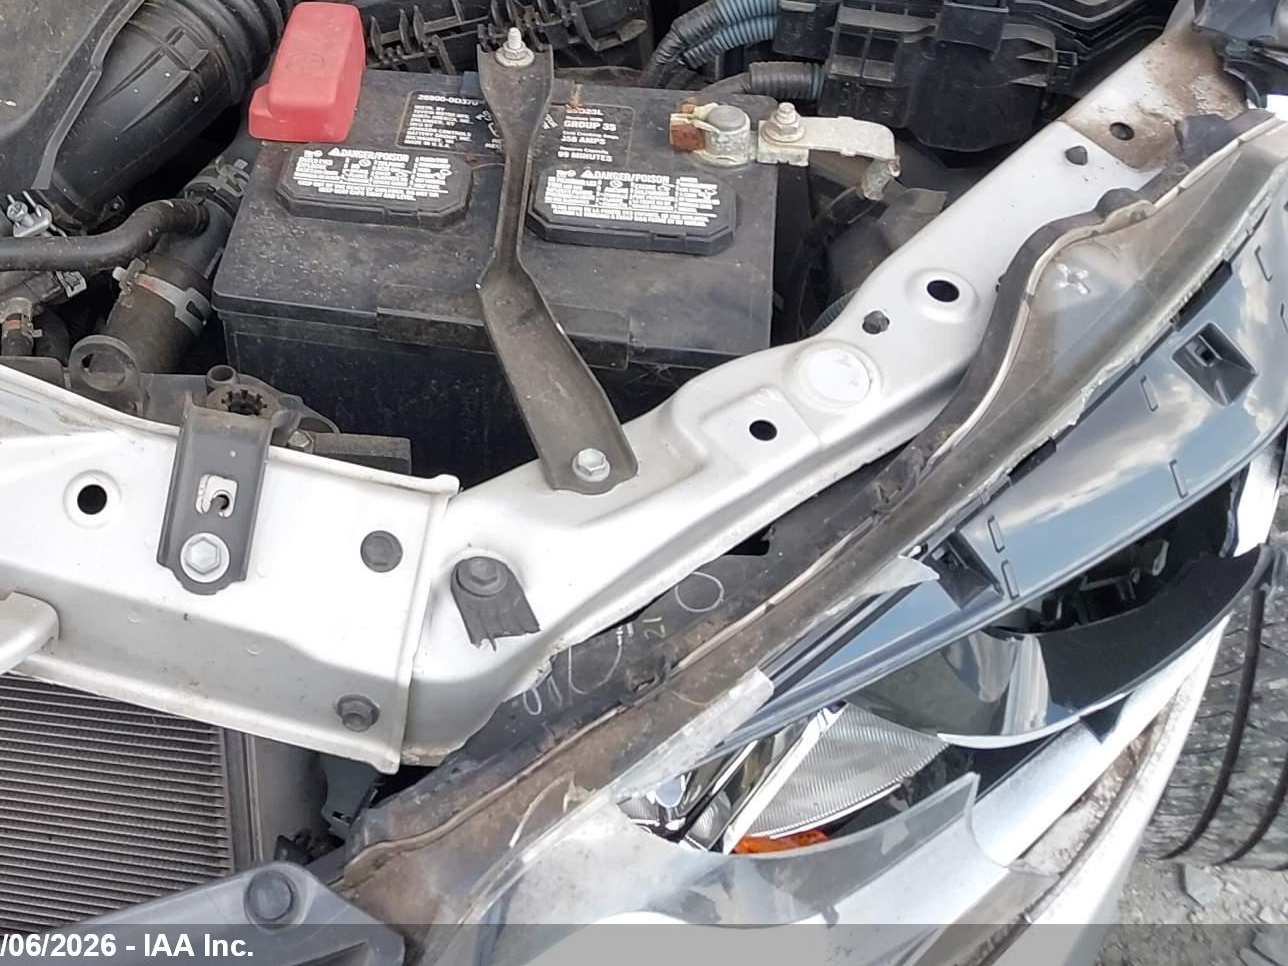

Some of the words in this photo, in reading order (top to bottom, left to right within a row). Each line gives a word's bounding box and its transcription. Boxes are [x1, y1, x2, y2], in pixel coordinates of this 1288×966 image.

[564, 120, 602, 130] GROUP
[578, 136, 606, 145] AMPS
[570, 152, 613, 162] MINUTES
[594, 170, 670, 184] DANGER/POISON
